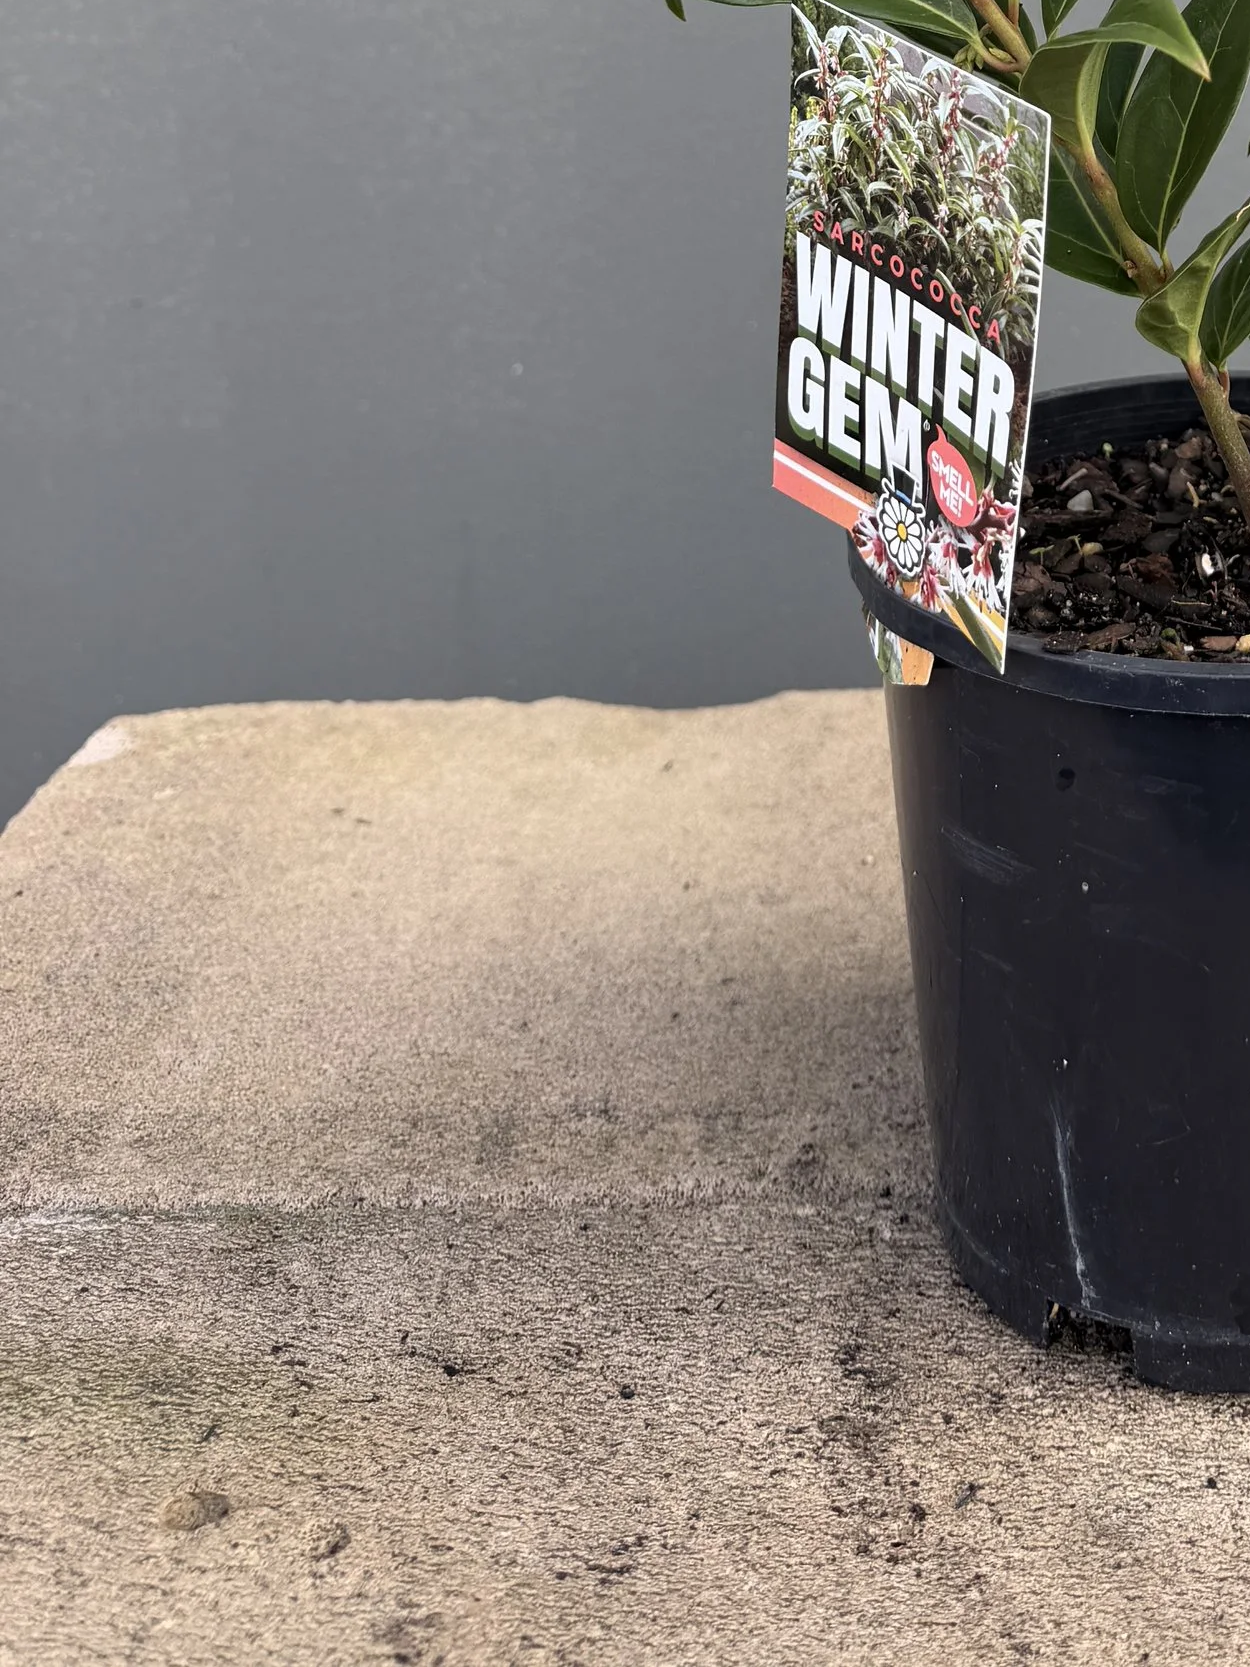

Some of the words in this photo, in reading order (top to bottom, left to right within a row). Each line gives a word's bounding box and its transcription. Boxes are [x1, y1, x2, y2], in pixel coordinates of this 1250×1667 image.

[814, 210, 1000, 344] SARCOCOCCA
[788, 337, 922, 490] GEM
[796, 231, 1015, 476] WINTER
[930, 449, 975, 507] SMELL
[939, 486, 962, 518] ME!
